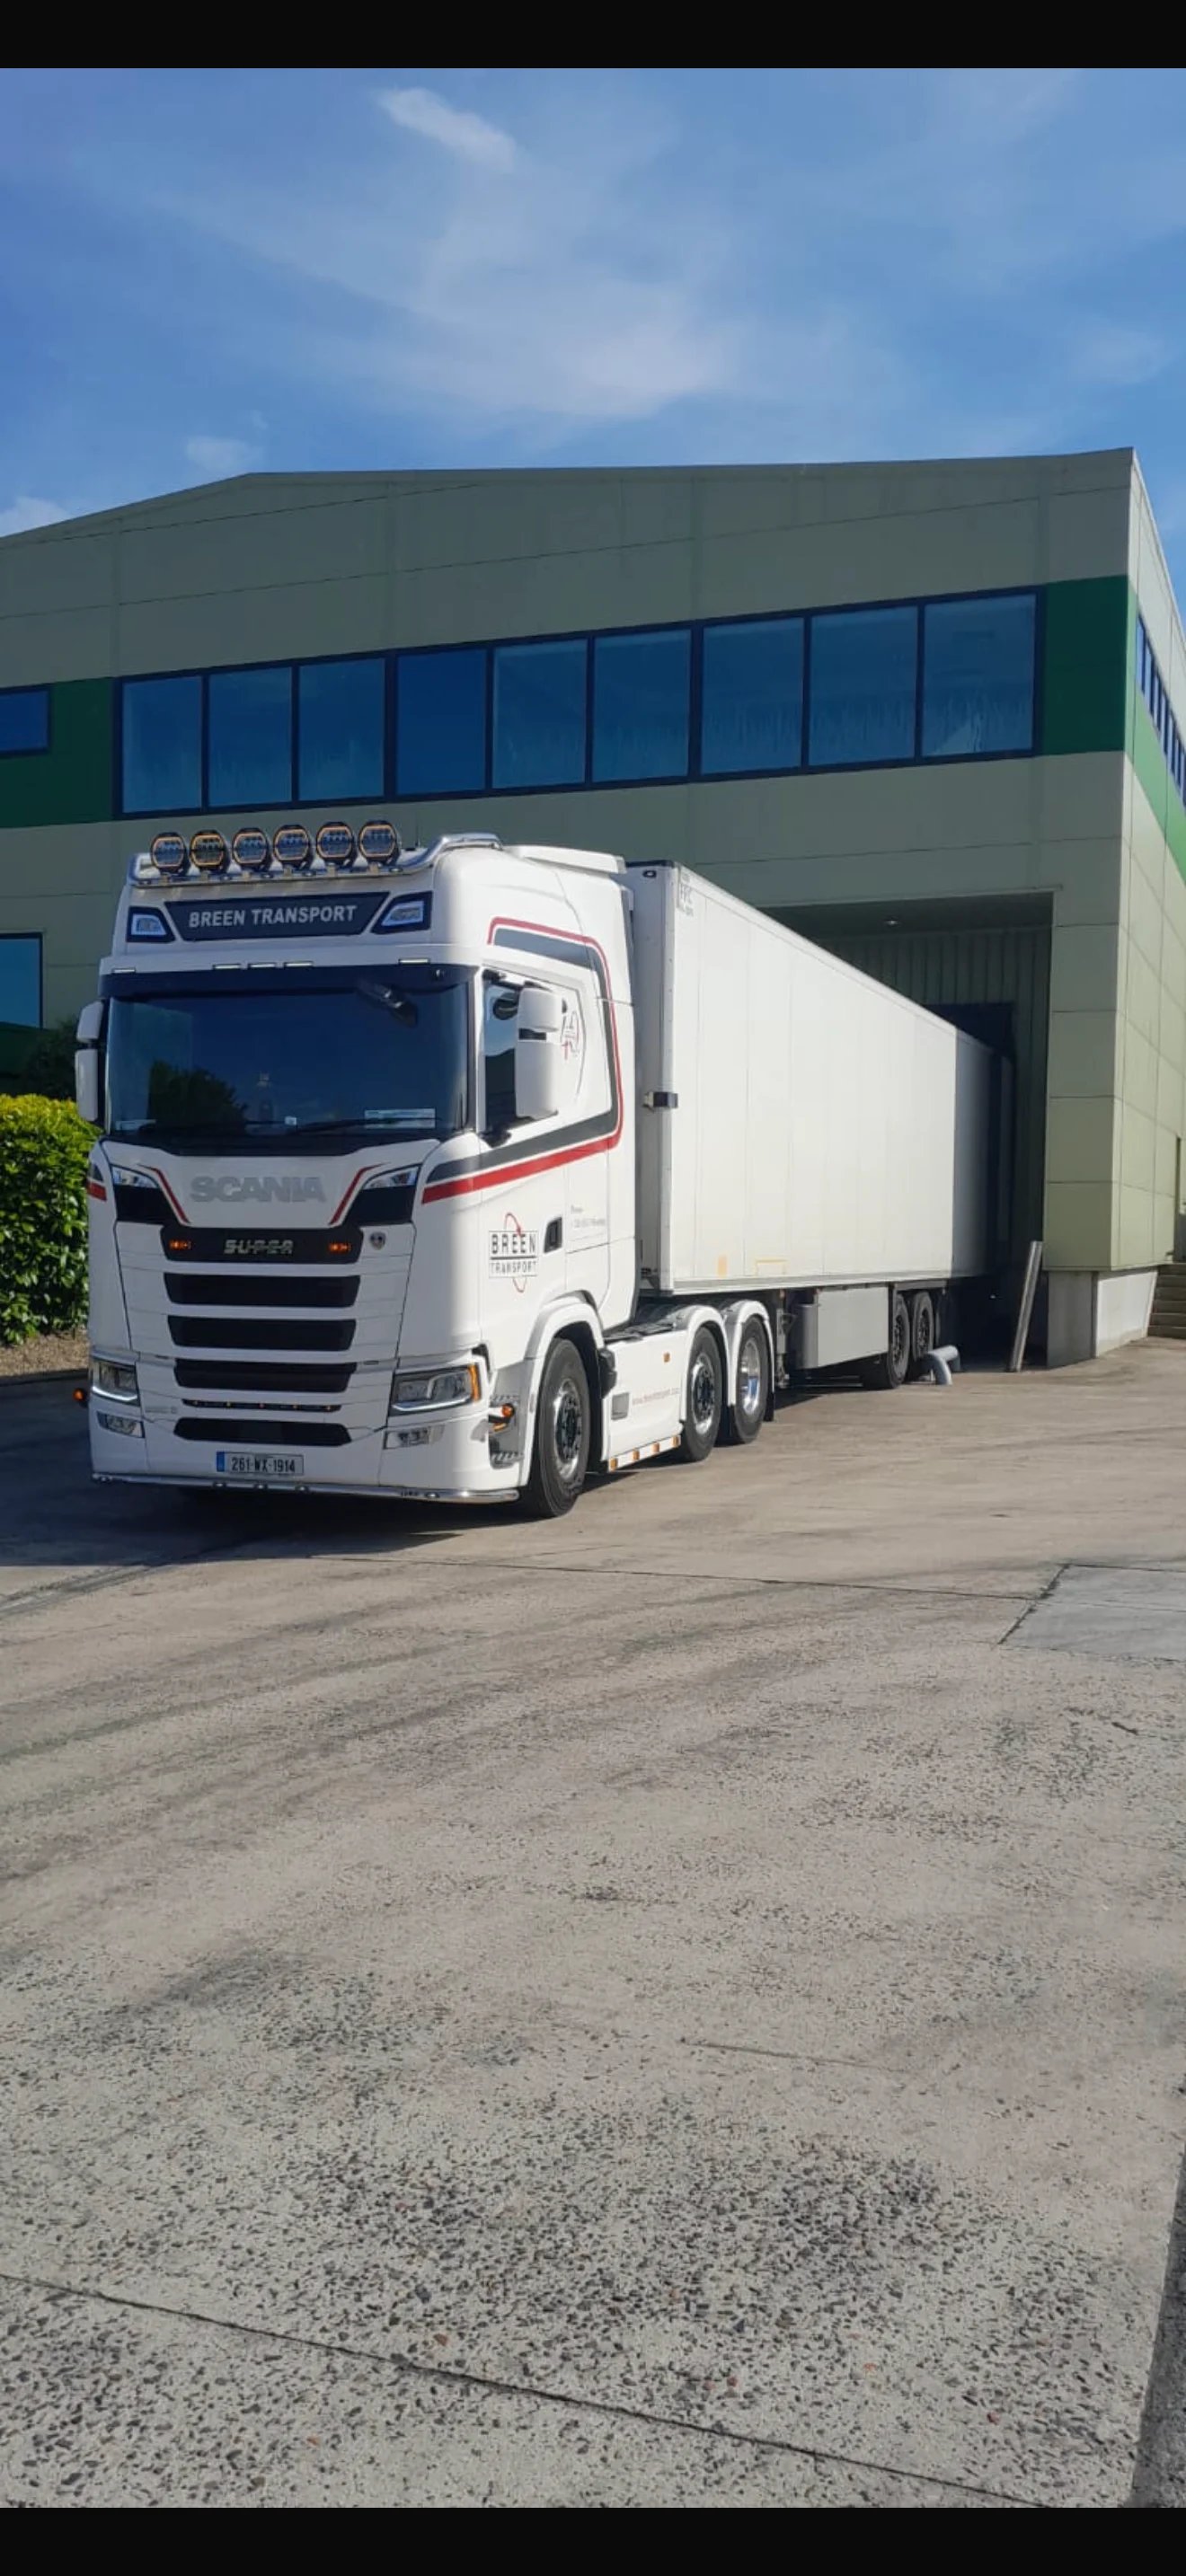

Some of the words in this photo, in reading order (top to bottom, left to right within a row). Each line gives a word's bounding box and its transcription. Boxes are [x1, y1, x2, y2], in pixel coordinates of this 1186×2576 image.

[189, 910, 246, 928] BREEN
[251, 904, 358, 925] TRANSPORT
[190, 1176, 328, 1203] SCANIA
[224, 1239, 295, 1255] SUPER
[491, 1233, 536, 1254] BREEN
[491, 1260, 537, 1275] TRANSPORT
[231, 1456, 296, 1473] 261-WX-1914
